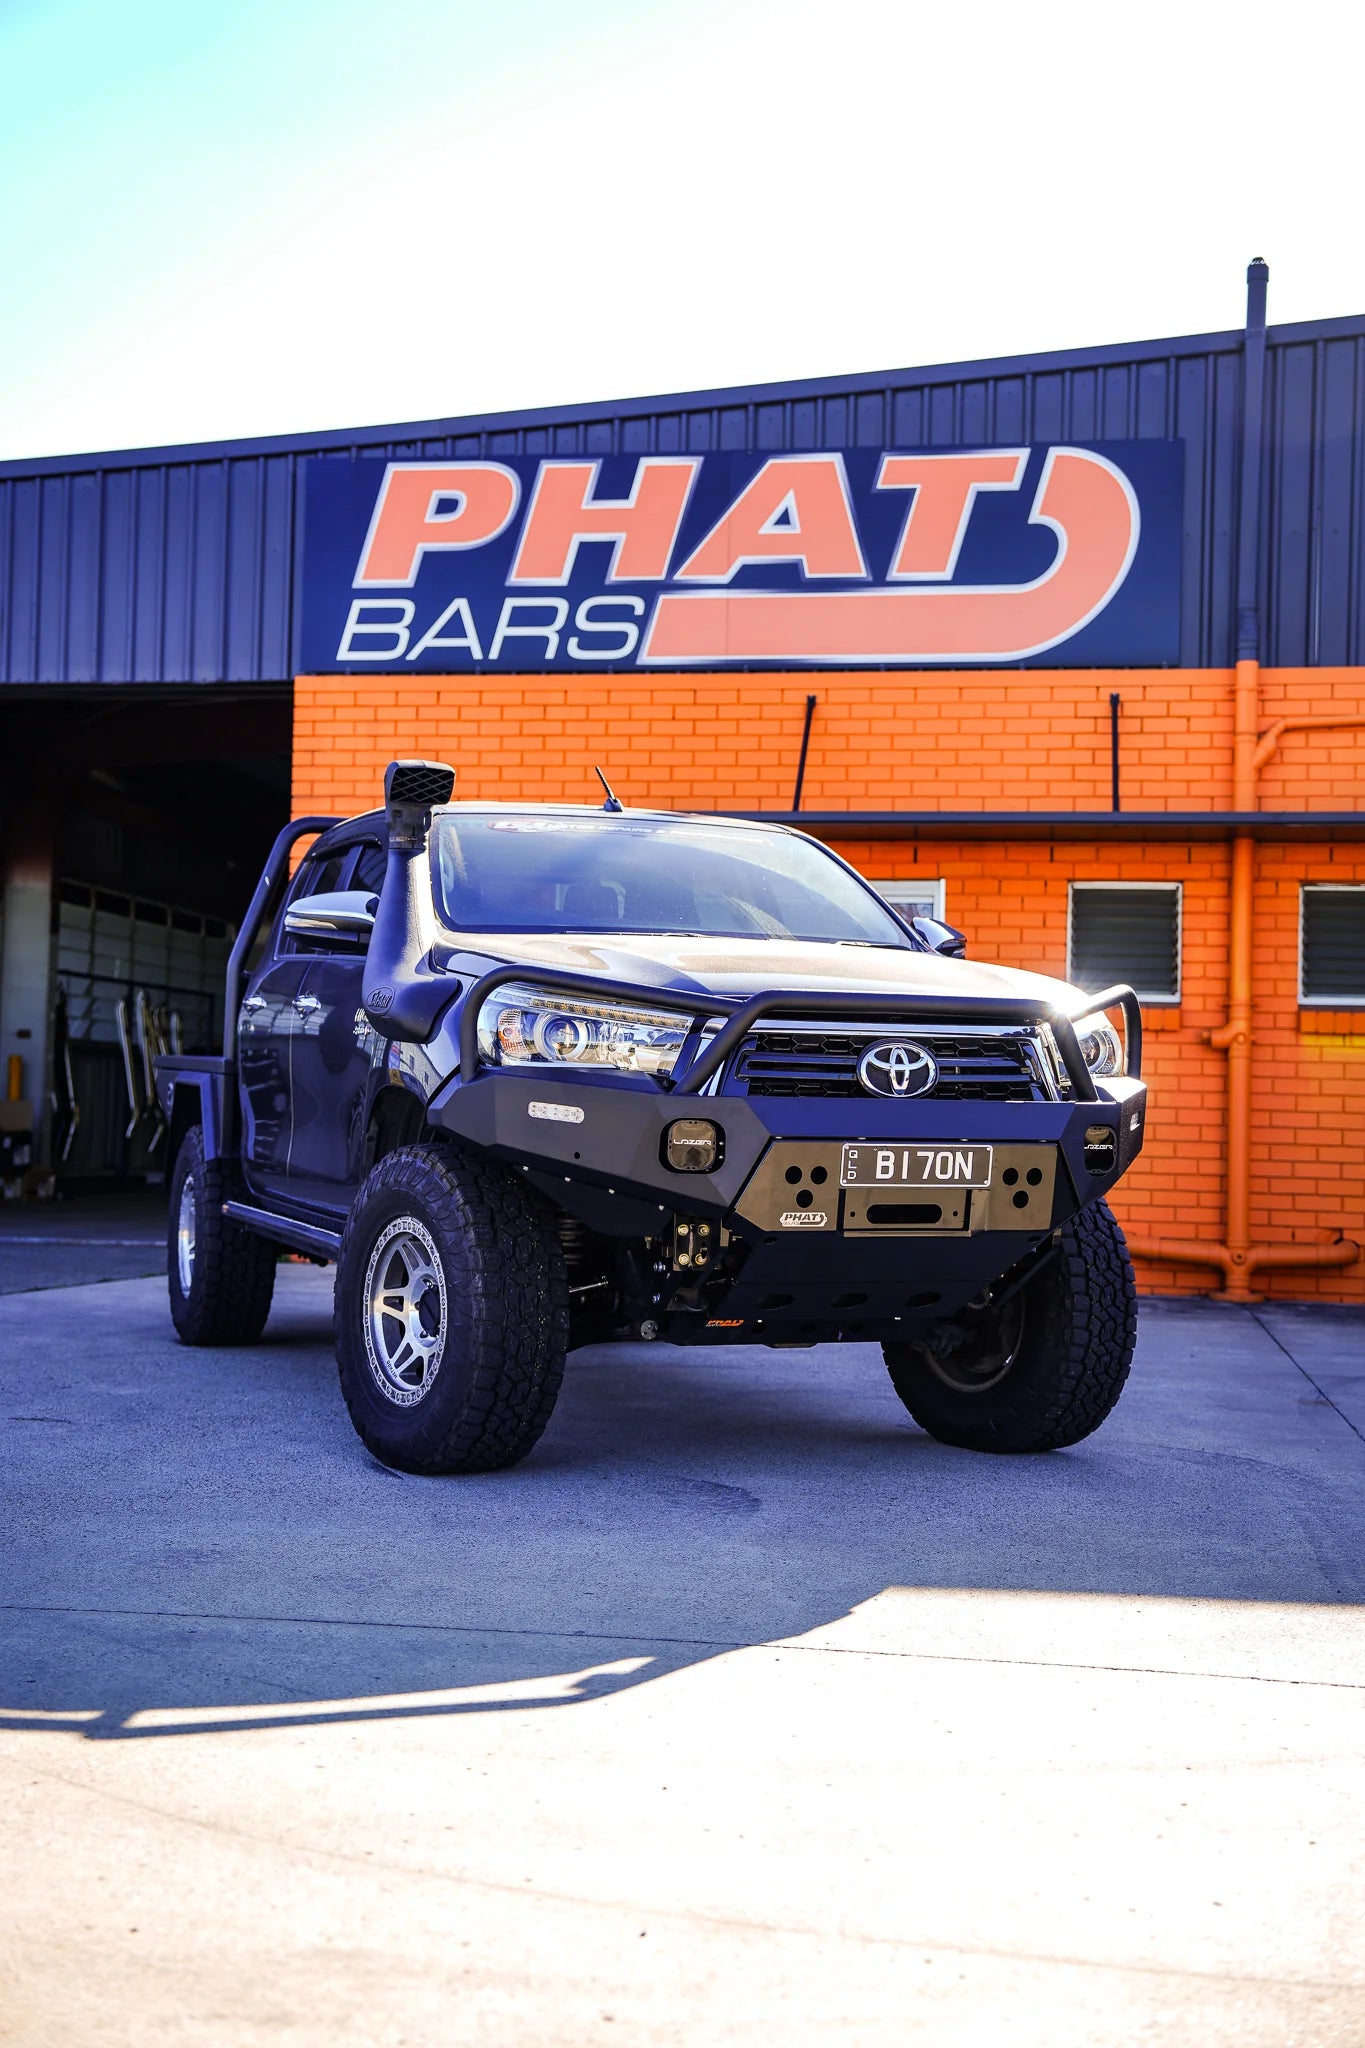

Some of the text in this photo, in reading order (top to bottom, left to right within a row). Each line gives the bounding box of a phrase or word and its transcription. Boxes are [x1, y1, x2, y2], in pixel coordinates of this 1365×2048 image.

[336, 594, 646, 662] BARS
[847, 1150, 859, 1180] QLD
[784, 1213, 819, 1221] PHAT
